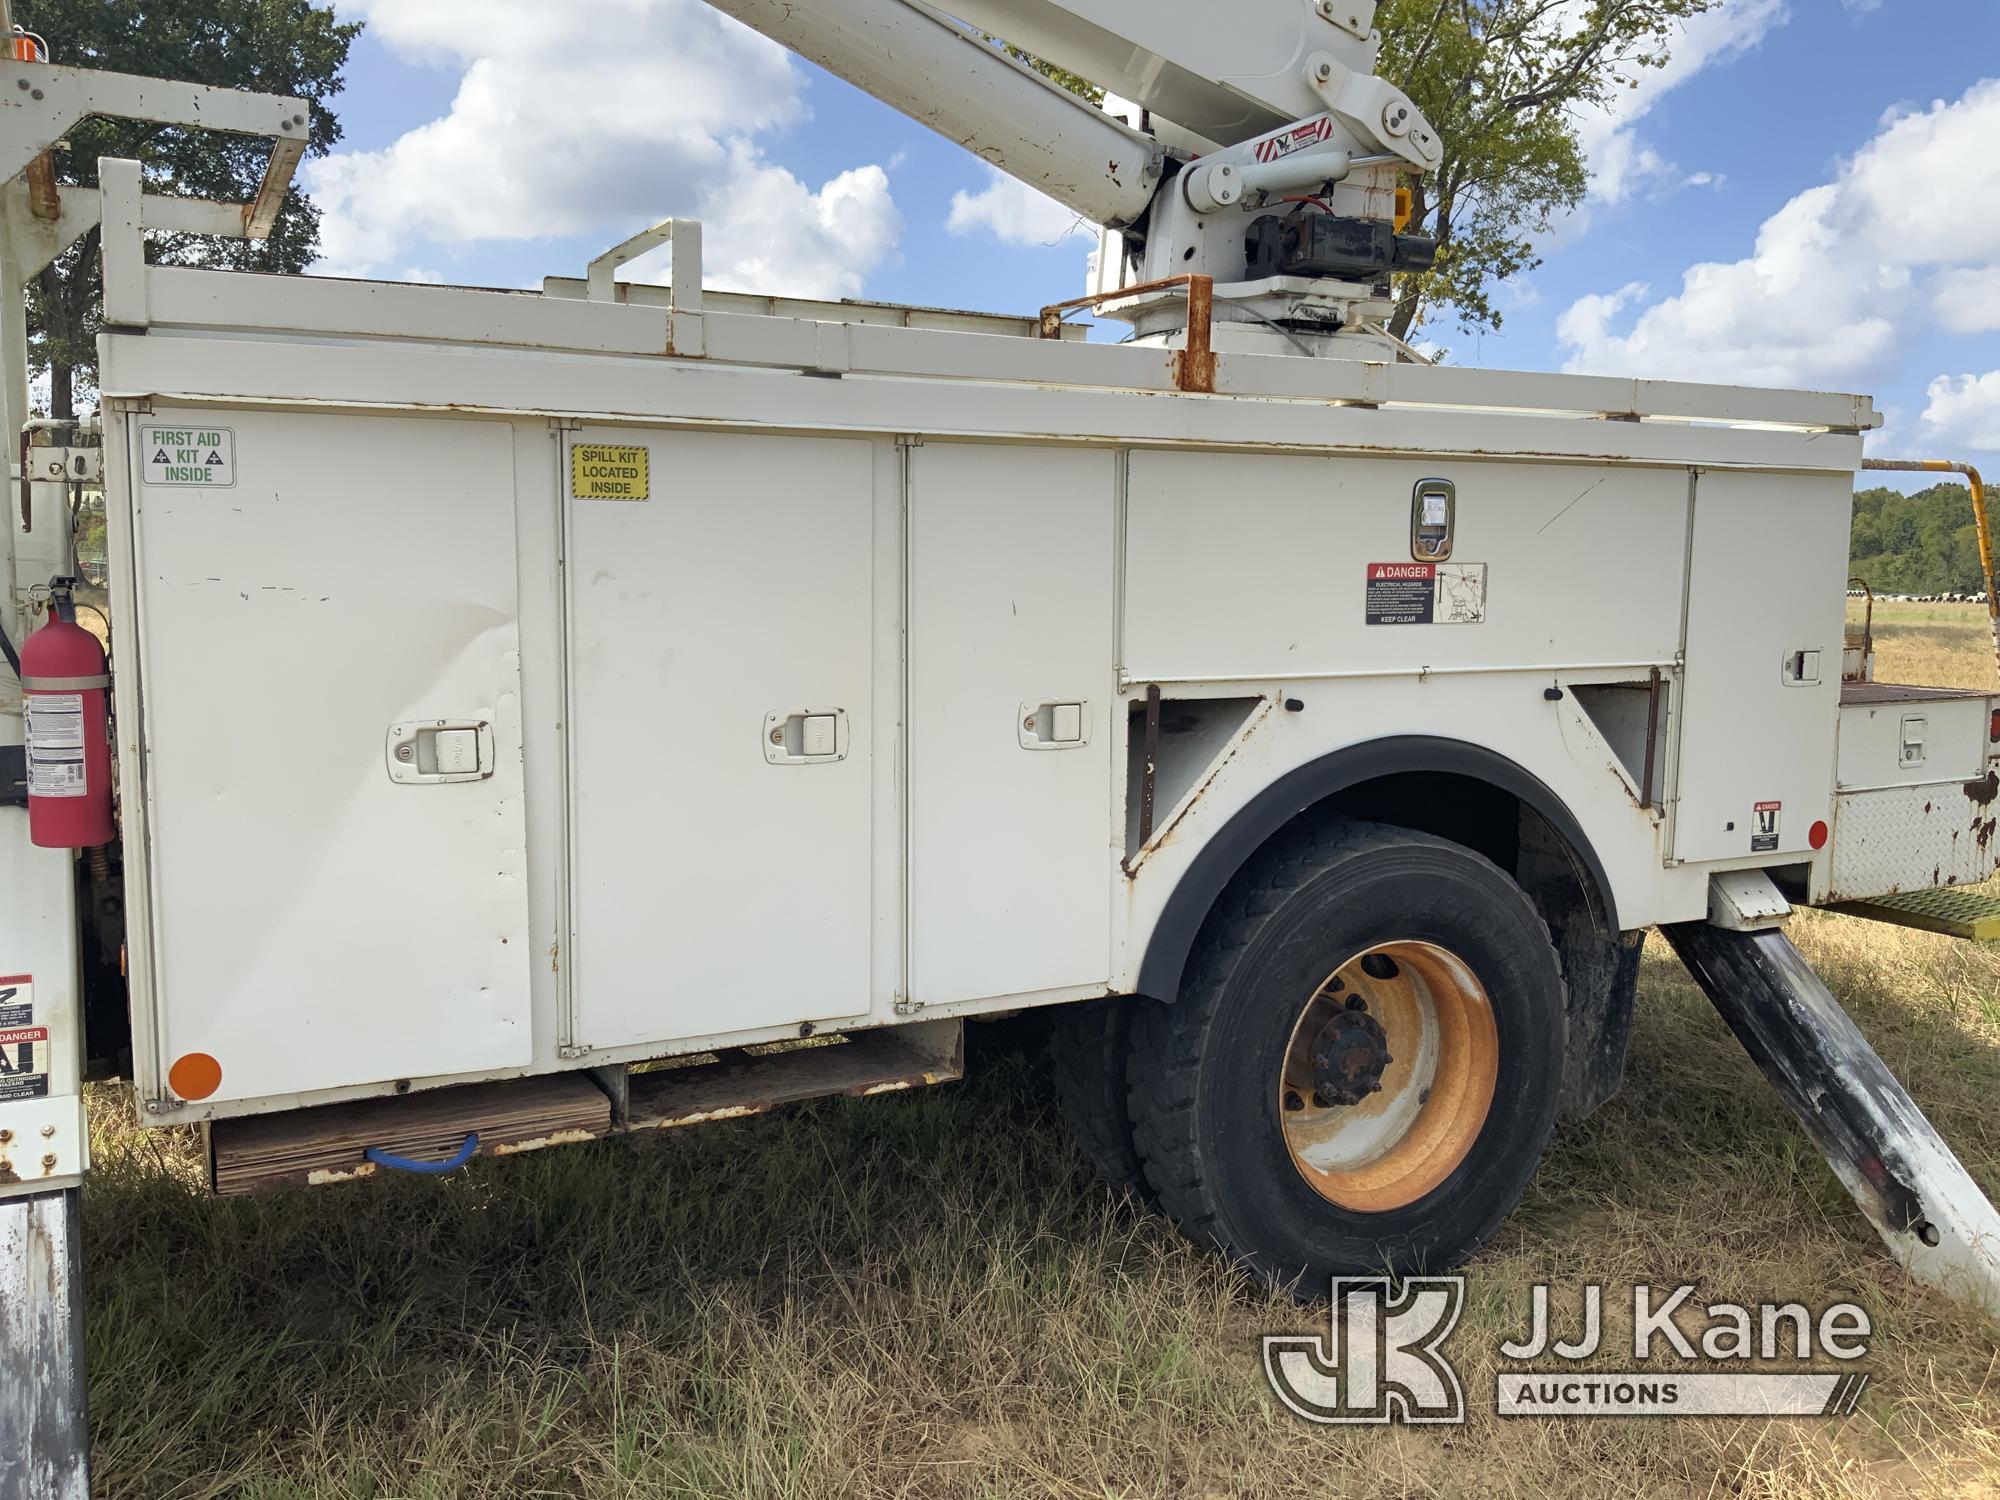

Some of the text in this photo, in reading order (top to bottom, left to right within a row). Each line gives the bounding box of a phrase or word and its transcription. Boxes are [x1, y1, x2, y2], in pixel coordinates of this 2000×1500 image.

[152, 430, 221, 447] FIRST AID
[176, 449, 199, 464] KIT
[582, 450, 638, 463] SPILL KIT
[165, 466, 213, 482] INSIDE
[582, 466, 639, 479] LOCATED
[591, 481, 631, 494] INSIDE
[1386, 566, 1428, 578] DANGER
[1396, 615, 1416, 623] CLEAR
[0, 1030, 41, 1042] DANGER
[6, 1074, 42, 1084] OUTRIGGER
[13, 1090, 34, 1098] CLEAR
